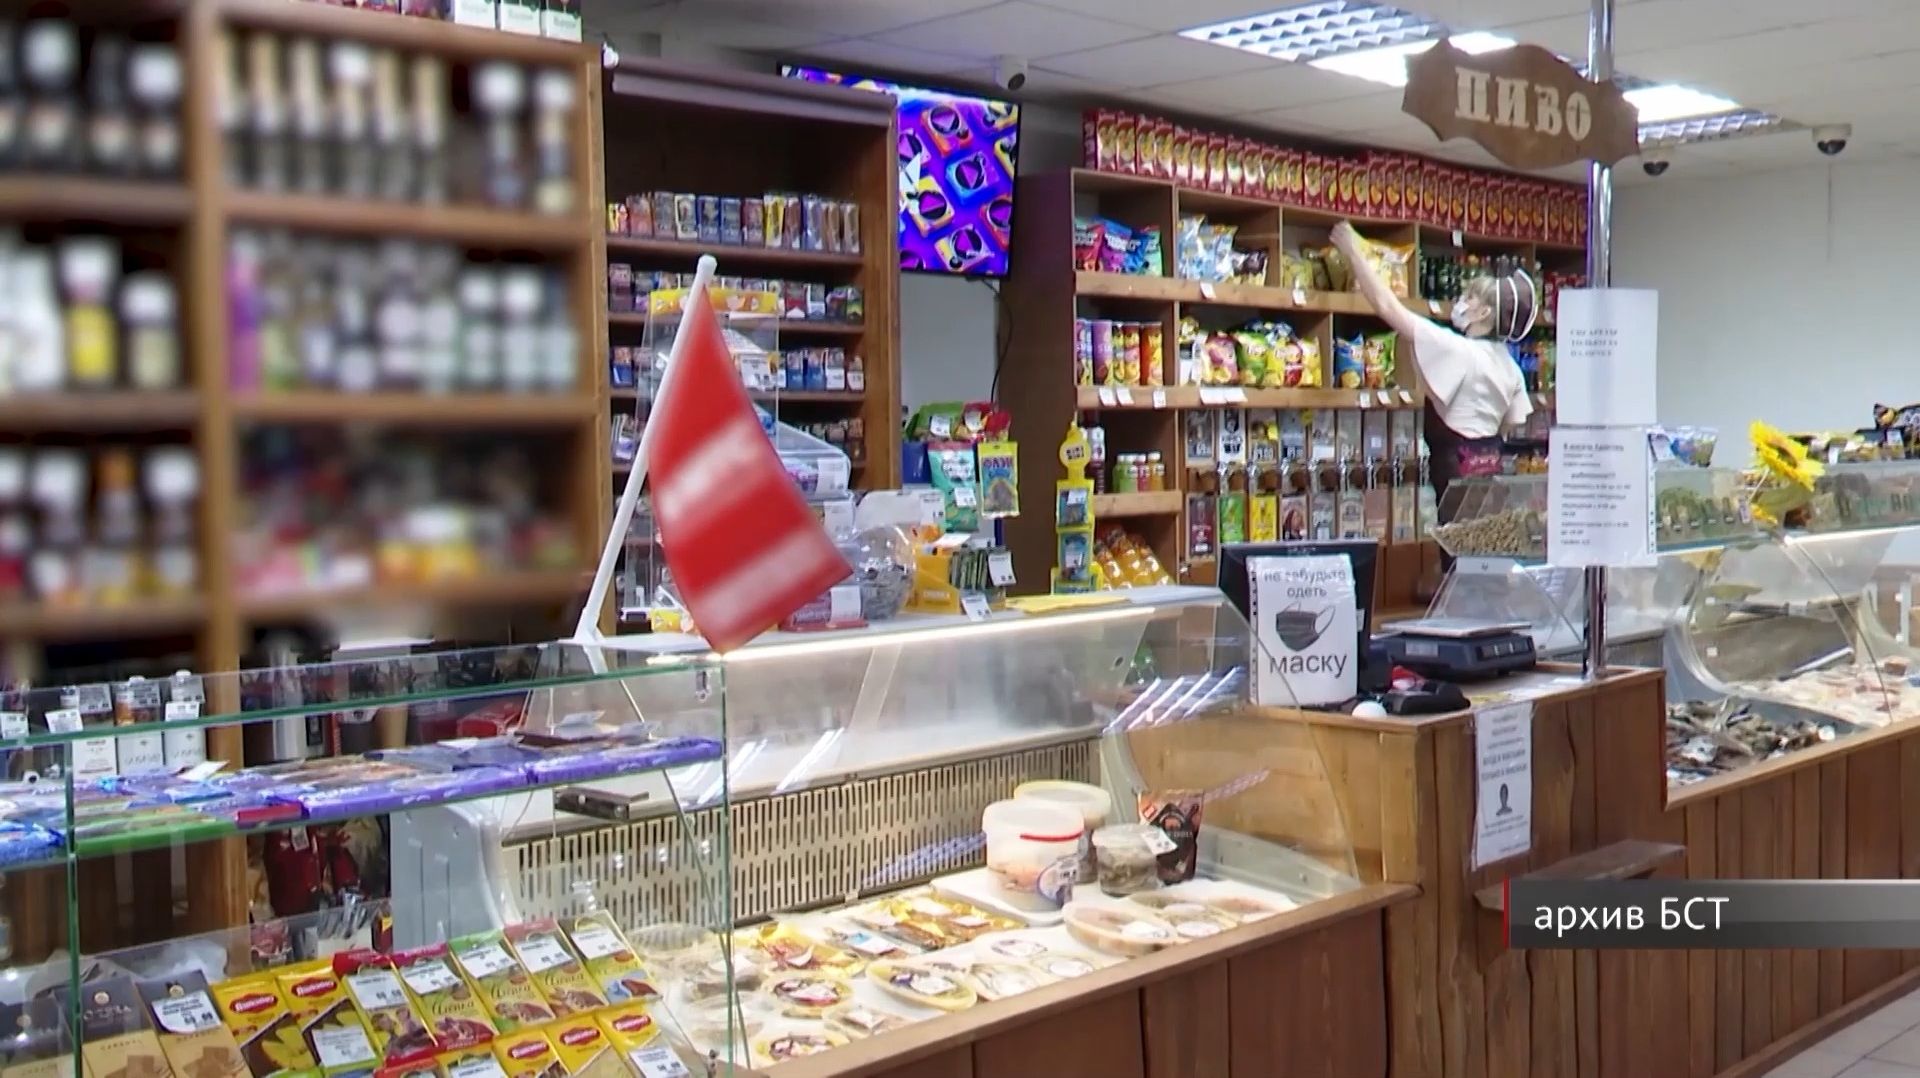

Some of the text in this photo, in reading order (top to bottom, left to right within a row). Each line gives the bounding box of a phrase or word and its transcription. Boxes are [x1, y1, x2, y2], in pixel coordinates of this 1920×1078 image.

[1455, 67, 1592, 141] ПИВО
[1264, 570, 1281, 582] не
[1286, 586, 1328, 599] одеть
[1269, 653, 1348, 678] маску
